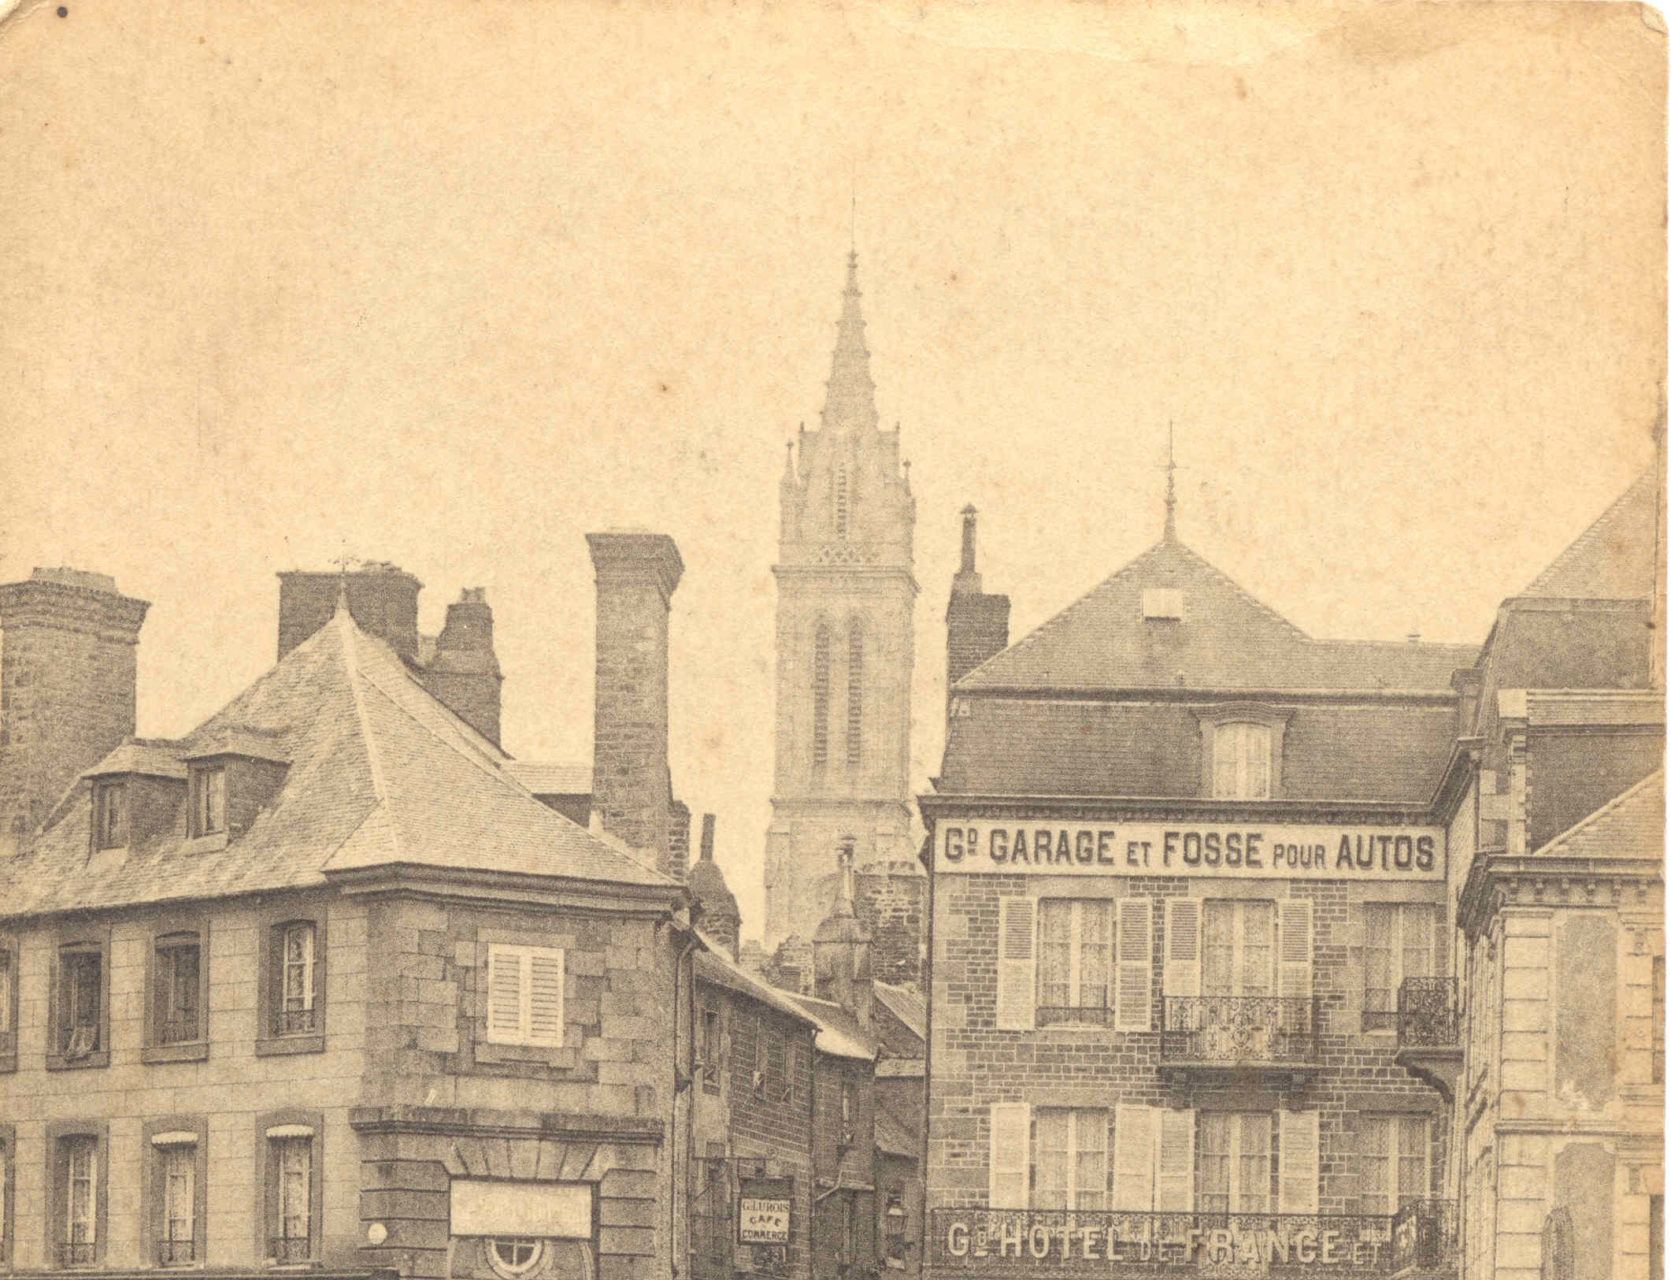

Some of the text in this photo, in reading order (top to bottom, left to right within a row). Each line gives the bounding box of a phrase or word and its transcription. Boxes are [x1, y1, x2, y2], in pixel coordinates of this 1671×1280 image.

[990, 828, 1116, 866] GARAGE
[1126, 841, 1152, 867] ET
[1163, 831, 1265, 868] FOSSE
[1273, 843, 1327, 870] POUR
[1335, 833, 1436, 872] AUTOS
[1000, 1222, 1125, 1261] HOTEL
[1139, 1238, 1171, 1262] DE
[1184, 1227, 1340, 1264] FRANCE
[1353, 1243, 1383, 1265] ET
